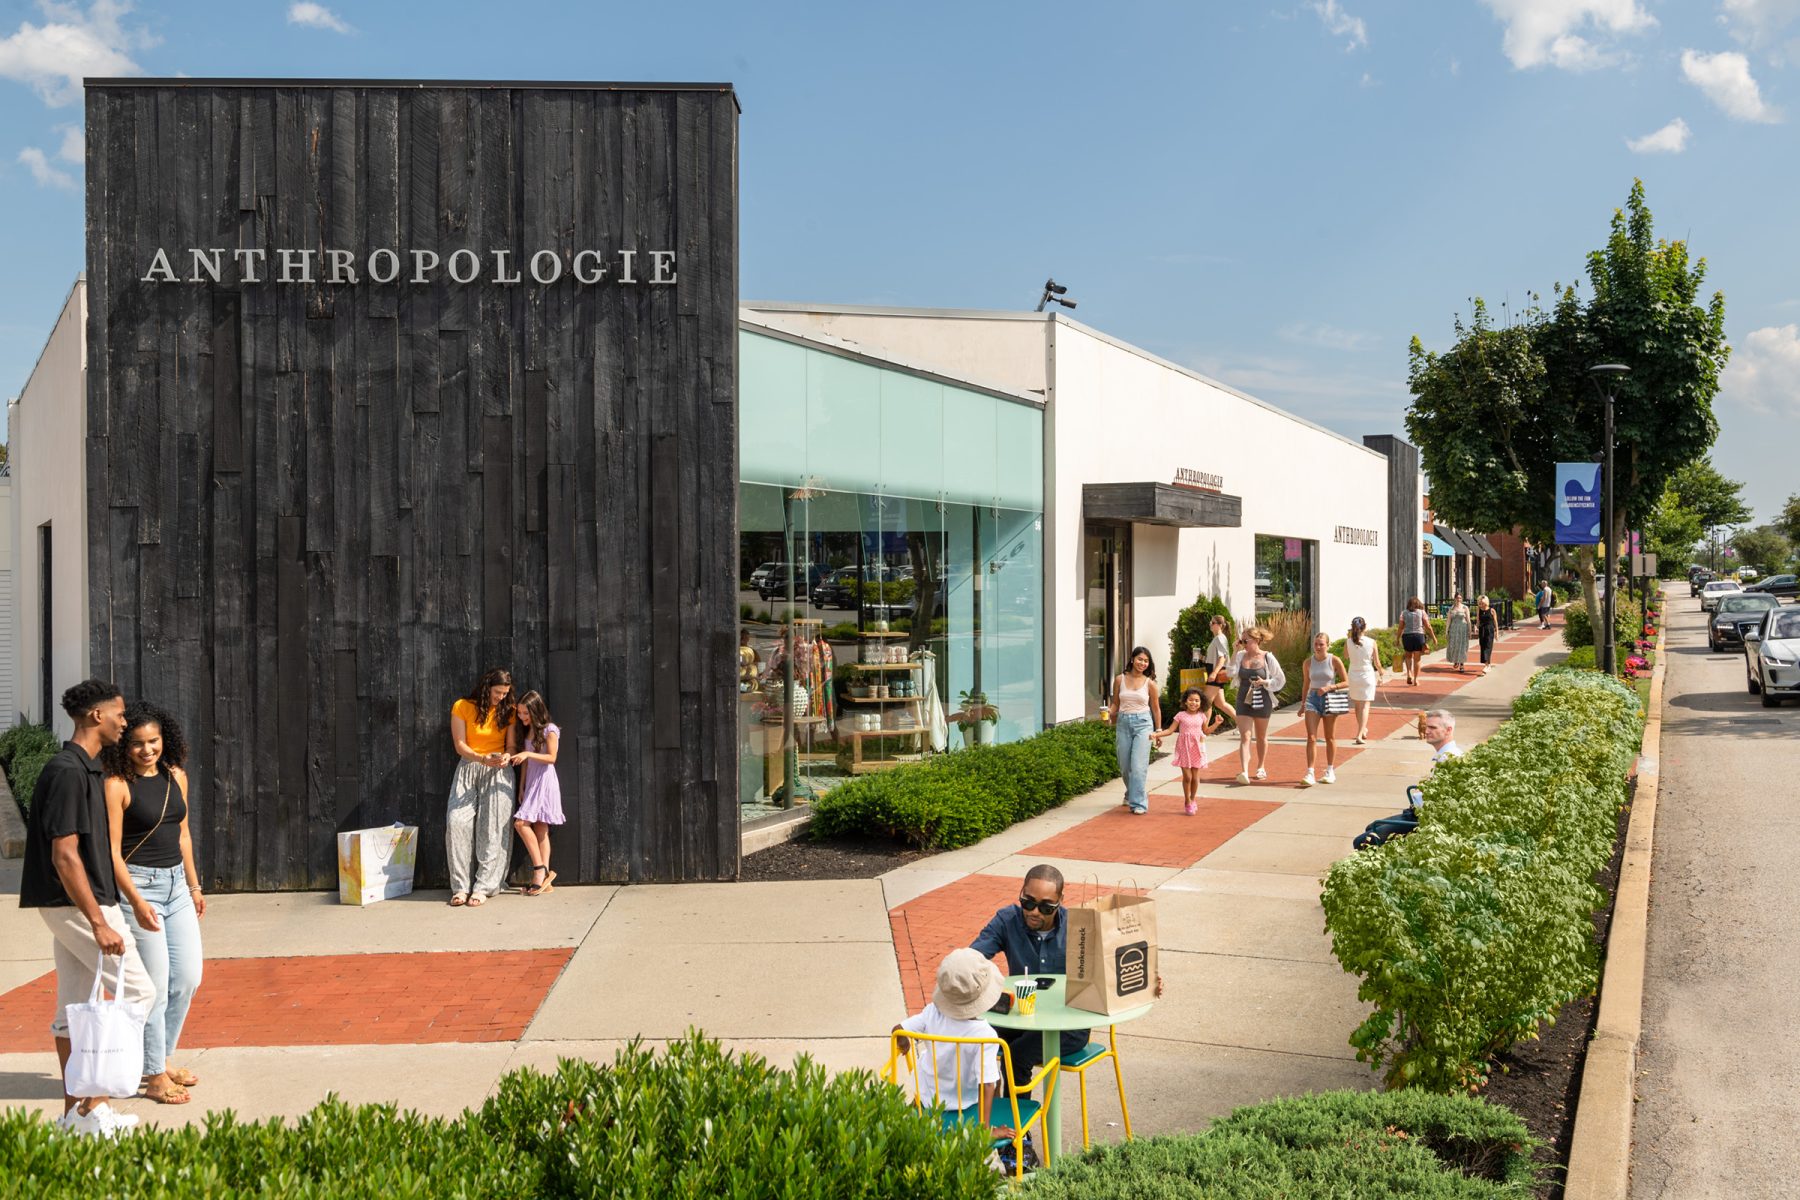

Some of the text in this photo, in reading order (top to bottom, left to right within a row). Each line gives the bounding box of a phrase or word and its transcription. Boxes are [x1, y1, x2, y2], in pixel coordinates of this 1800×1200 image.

[140, 248, 678, 284] ANTHROPOLOGIE
[1175, 467, 1223, 488] ANTHROPOLOGIE
[1333, 525, 1378, 546] ANTHROPOLOGIE
